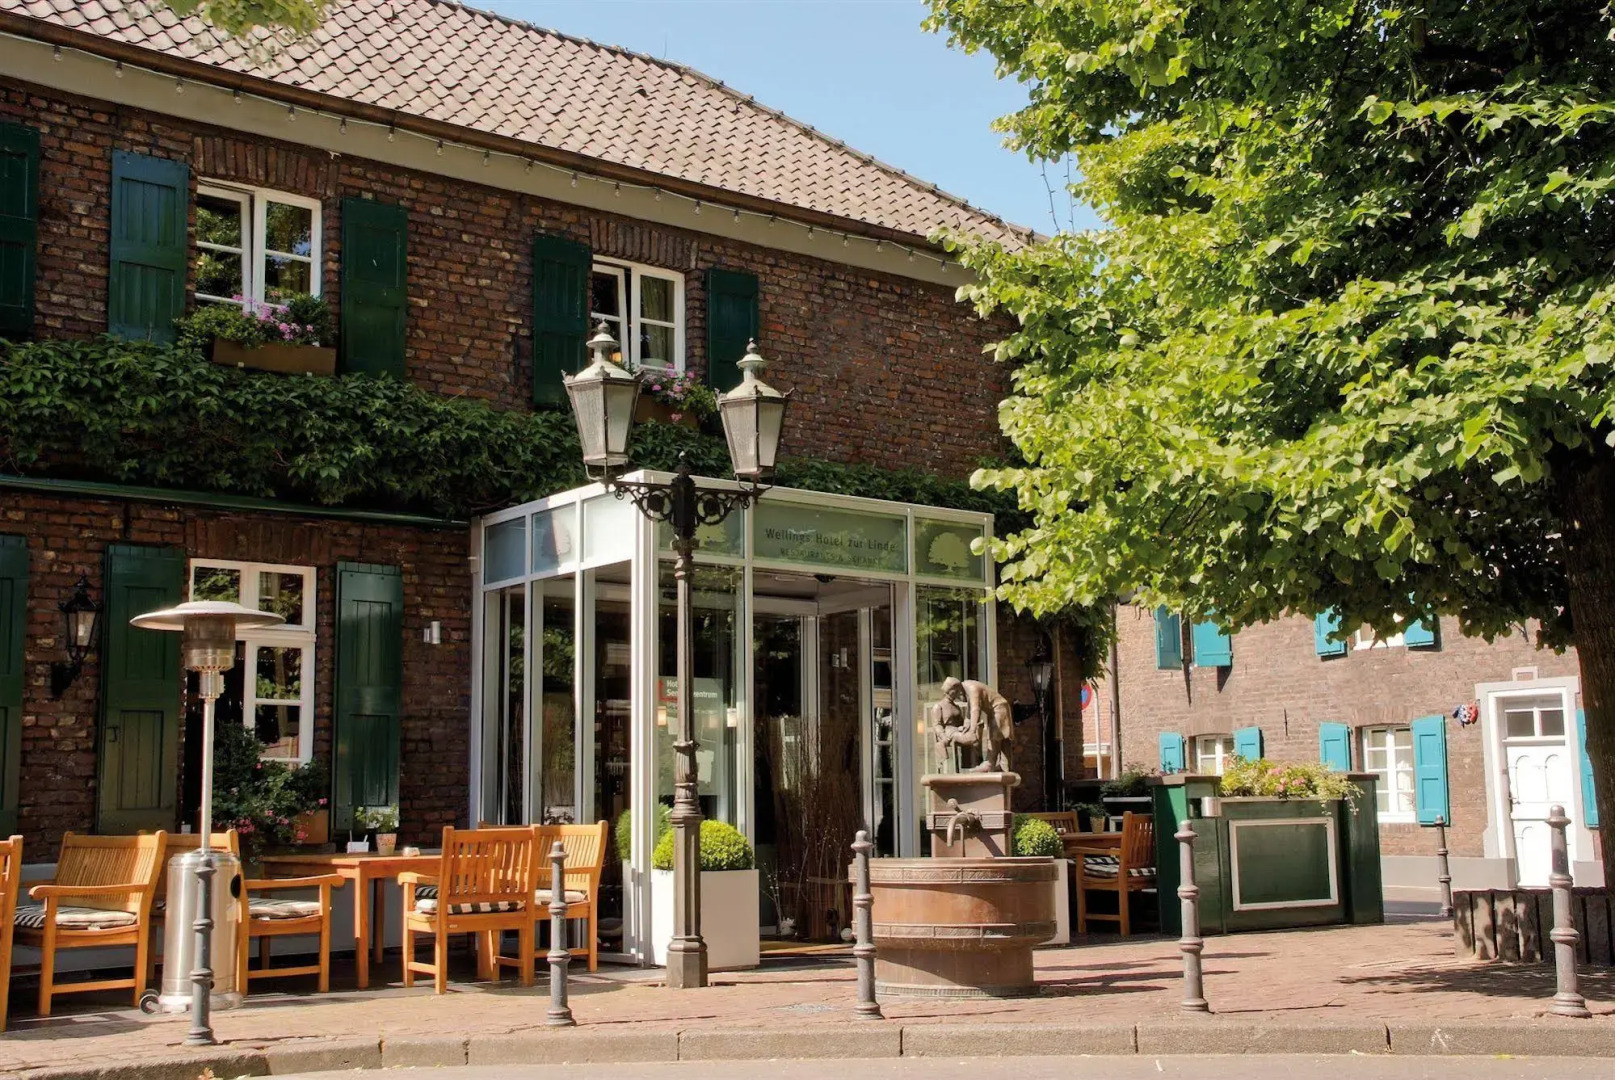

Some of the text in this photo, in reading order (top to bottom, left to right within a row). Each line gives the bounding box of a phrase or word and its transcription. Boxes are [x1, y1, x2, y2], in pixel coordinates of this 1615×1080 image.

[765, 528, 812, 544] Wellings
[815, 533, 843, 547] Hotel
[868, 539, 896, 553] Linde
